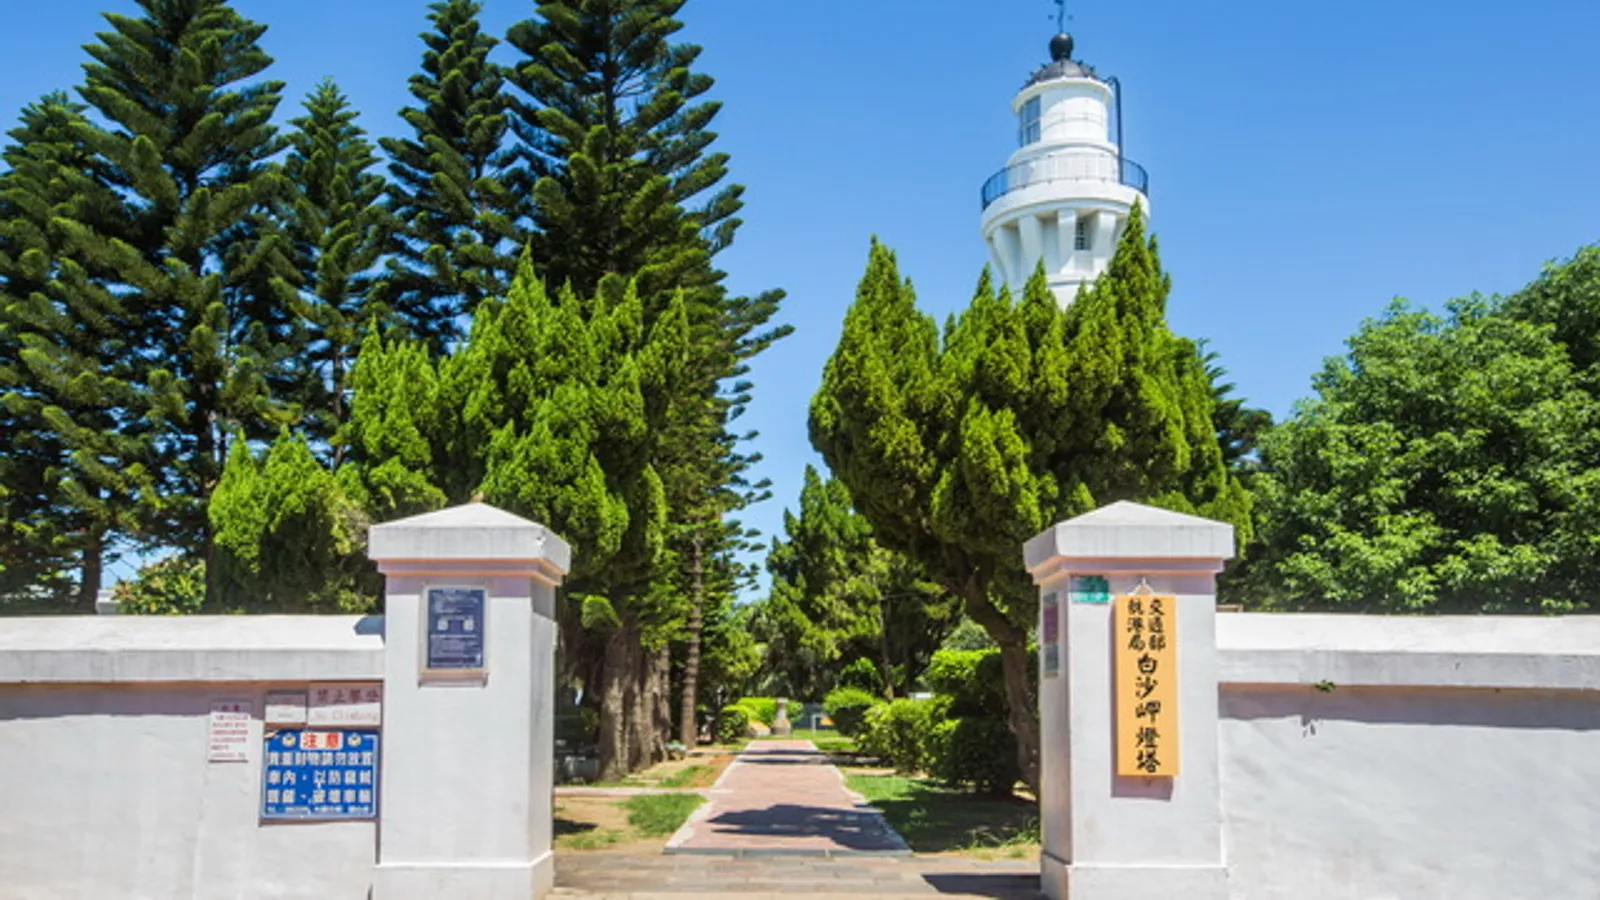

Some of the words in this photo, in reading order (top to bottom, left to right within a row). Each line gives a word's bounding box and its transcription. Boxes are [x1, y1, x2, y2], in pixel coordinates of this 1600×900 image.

[1127, 598, 1145, 651] 航港局
[1149, 598, 1166, 652] 交通部
[1135, 653, 1161, 773] 白沙岬燈塔
[303, 732, 340, 748] 注意
